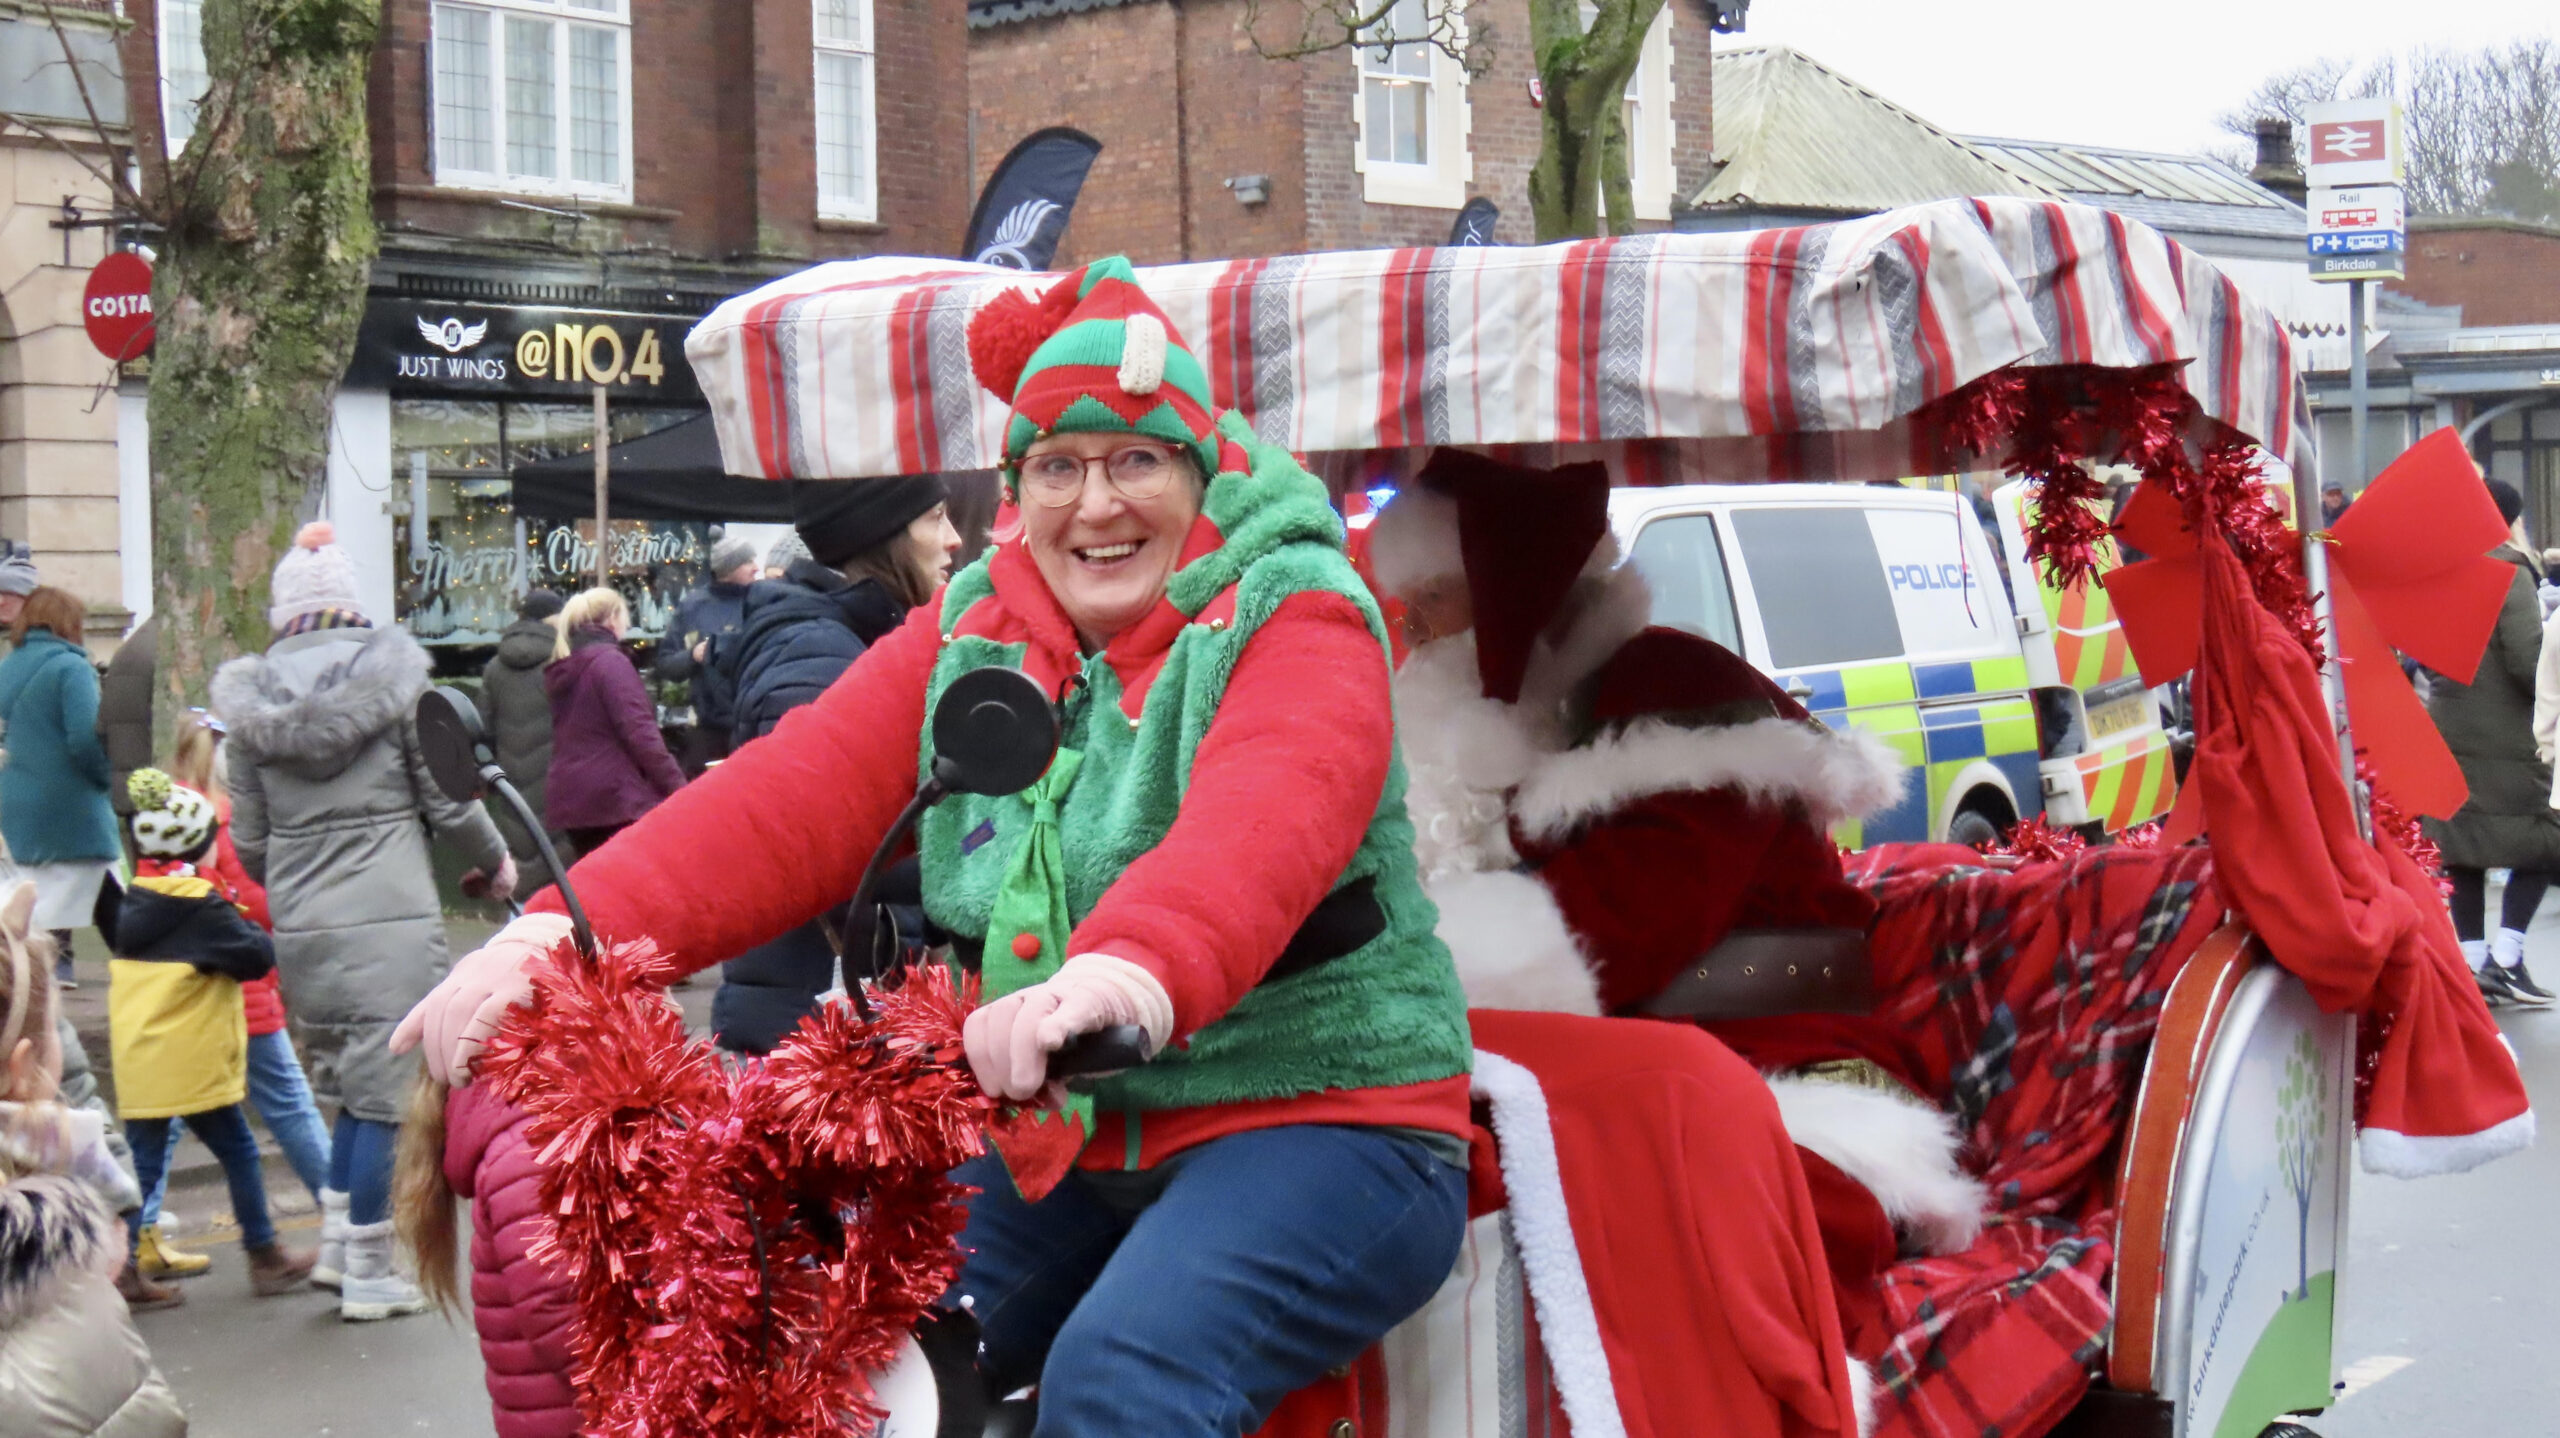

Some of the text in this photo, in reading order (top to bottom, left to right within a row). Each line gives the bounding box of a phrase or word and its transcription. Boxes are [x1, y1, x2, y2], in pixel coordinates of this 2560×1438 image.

[2339, 193, 2361, 204] Rail
[2325, 259, 2377, 272] Birkdale
[89, 294, 152, 318] COSTA
[398, 355, 507, 381] JUST WINGS
[408, 543, 519, 606] Merry
[1888, 563, 1977, 591] POLICE
